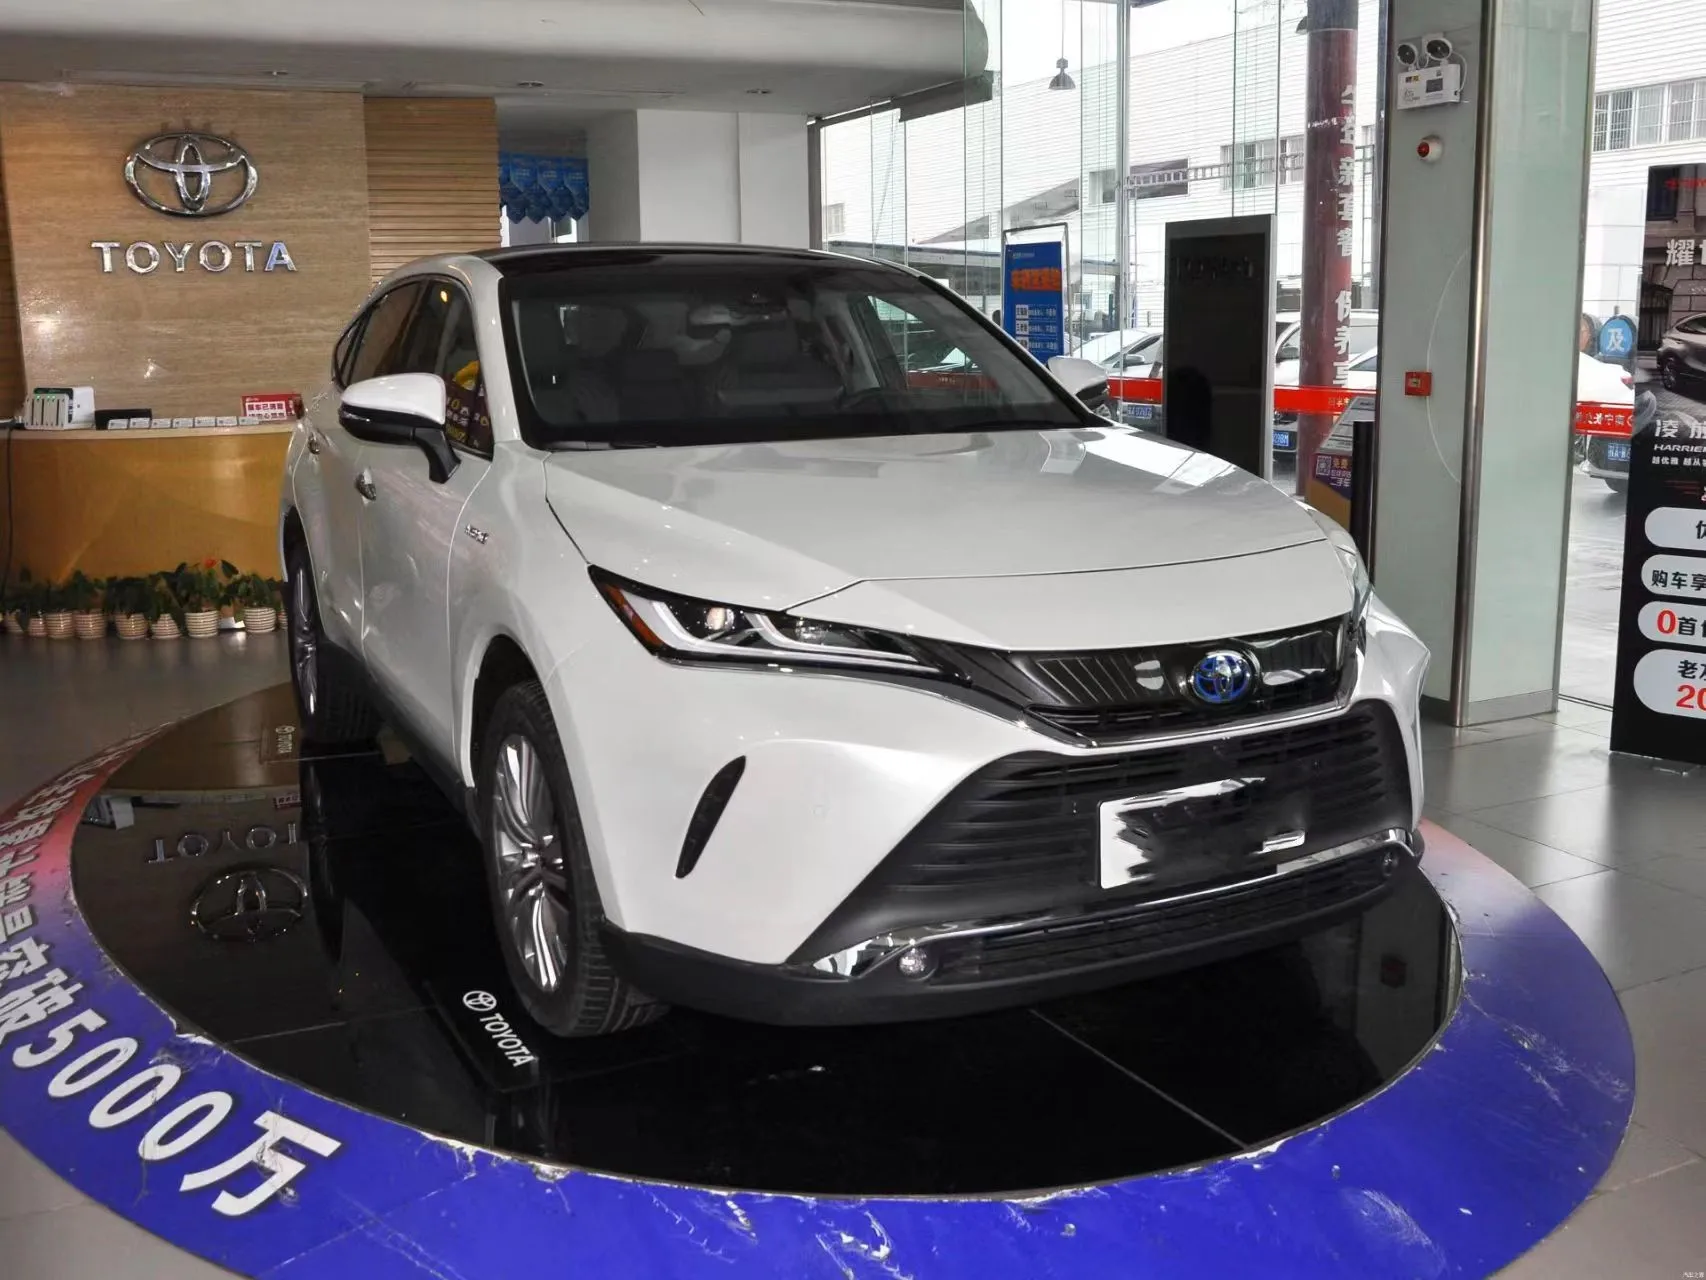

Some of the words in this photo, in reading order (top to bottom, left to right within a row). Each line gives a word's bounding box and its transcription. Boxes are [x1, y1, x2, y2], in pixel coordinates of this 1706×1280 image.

[90, 240, 298, 274] TOYOTA
[1651, 570, 1706, 591] 购车享
[479, 1012, 535, 1068] TOYOTA
